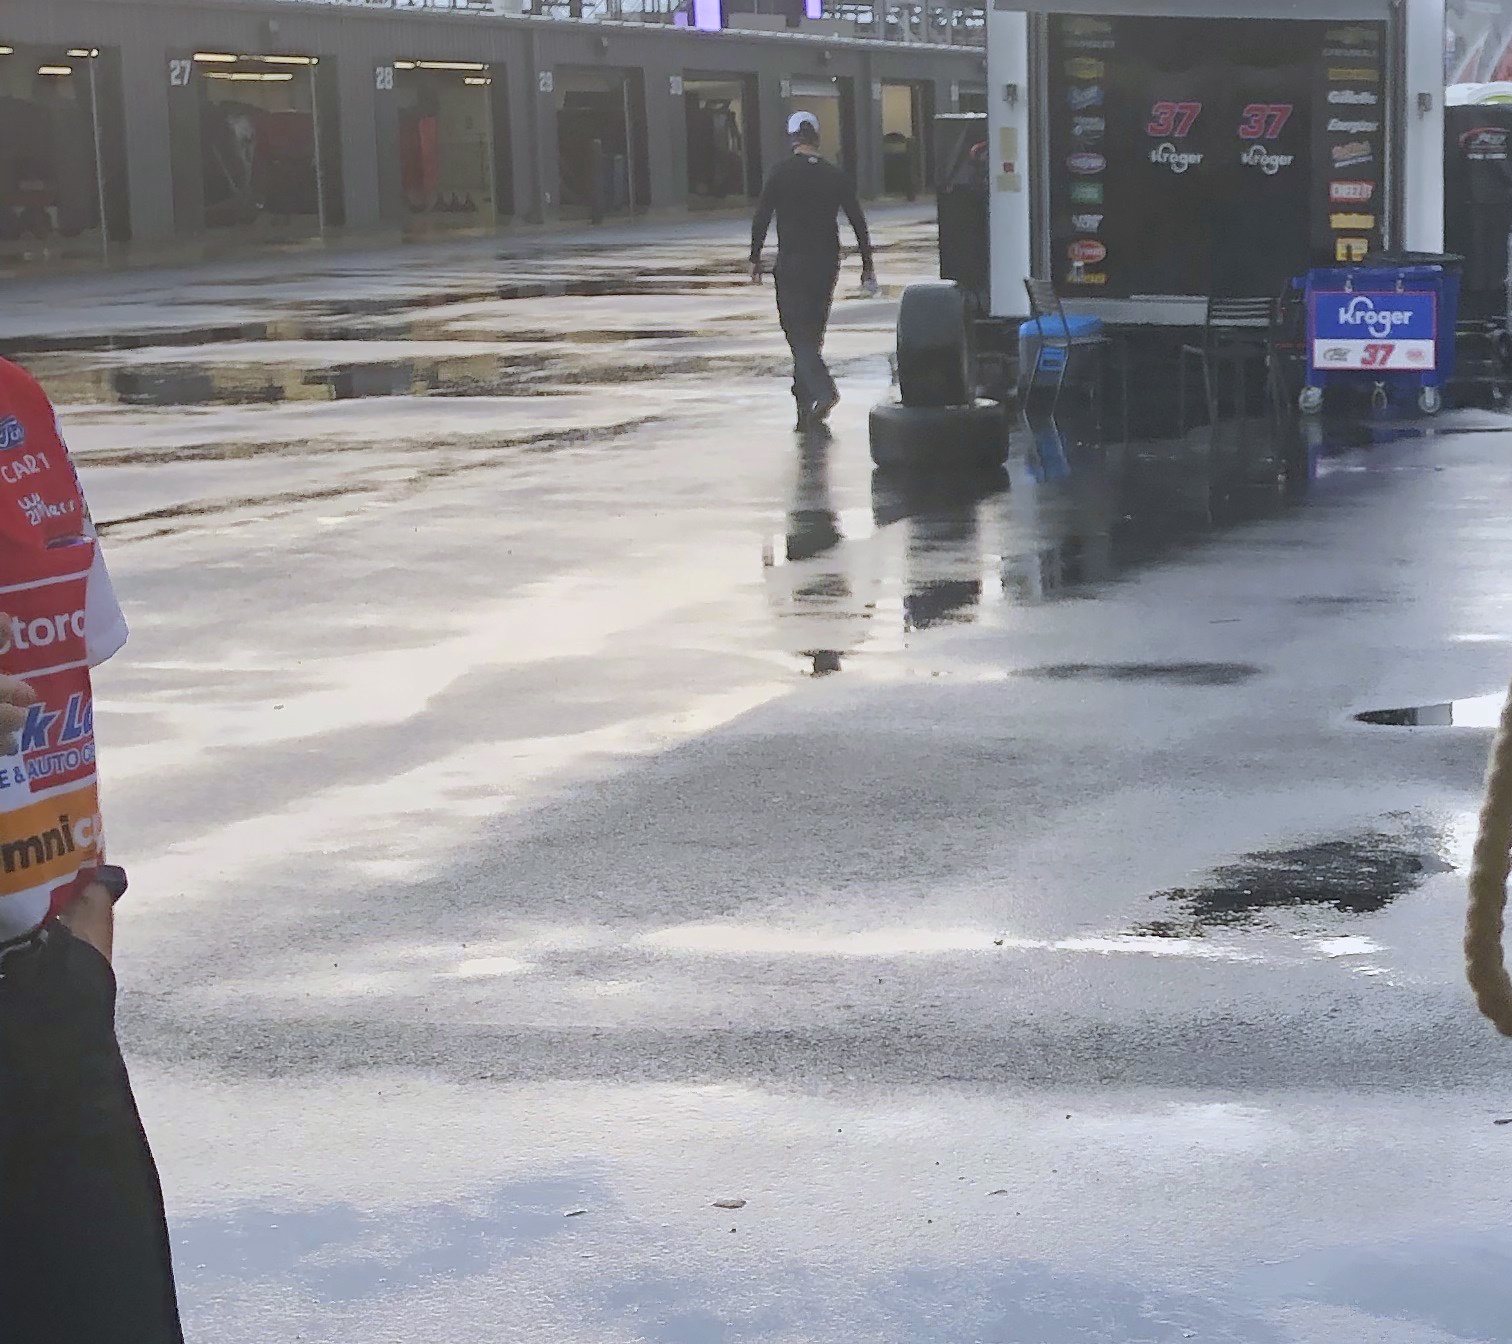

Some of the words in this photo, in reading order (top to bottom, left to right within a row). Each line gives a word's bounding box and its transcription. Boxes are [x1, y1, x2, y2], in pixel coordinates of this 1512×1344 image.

[169, 59, 191, 86] 27
[1147, 102, 1202, 137] 37
[1239, 103, 1293, 139] 37
[1150, 142, 1204, 173] Kroger
[1241, 144, 1295, 175] Kroger
[1338, 296, 1414, 338] Kroger
[1361, 343, 1396, 366] 37
[13, 766, 26, 784] &
[27, 749, 80, 778] AUTO
